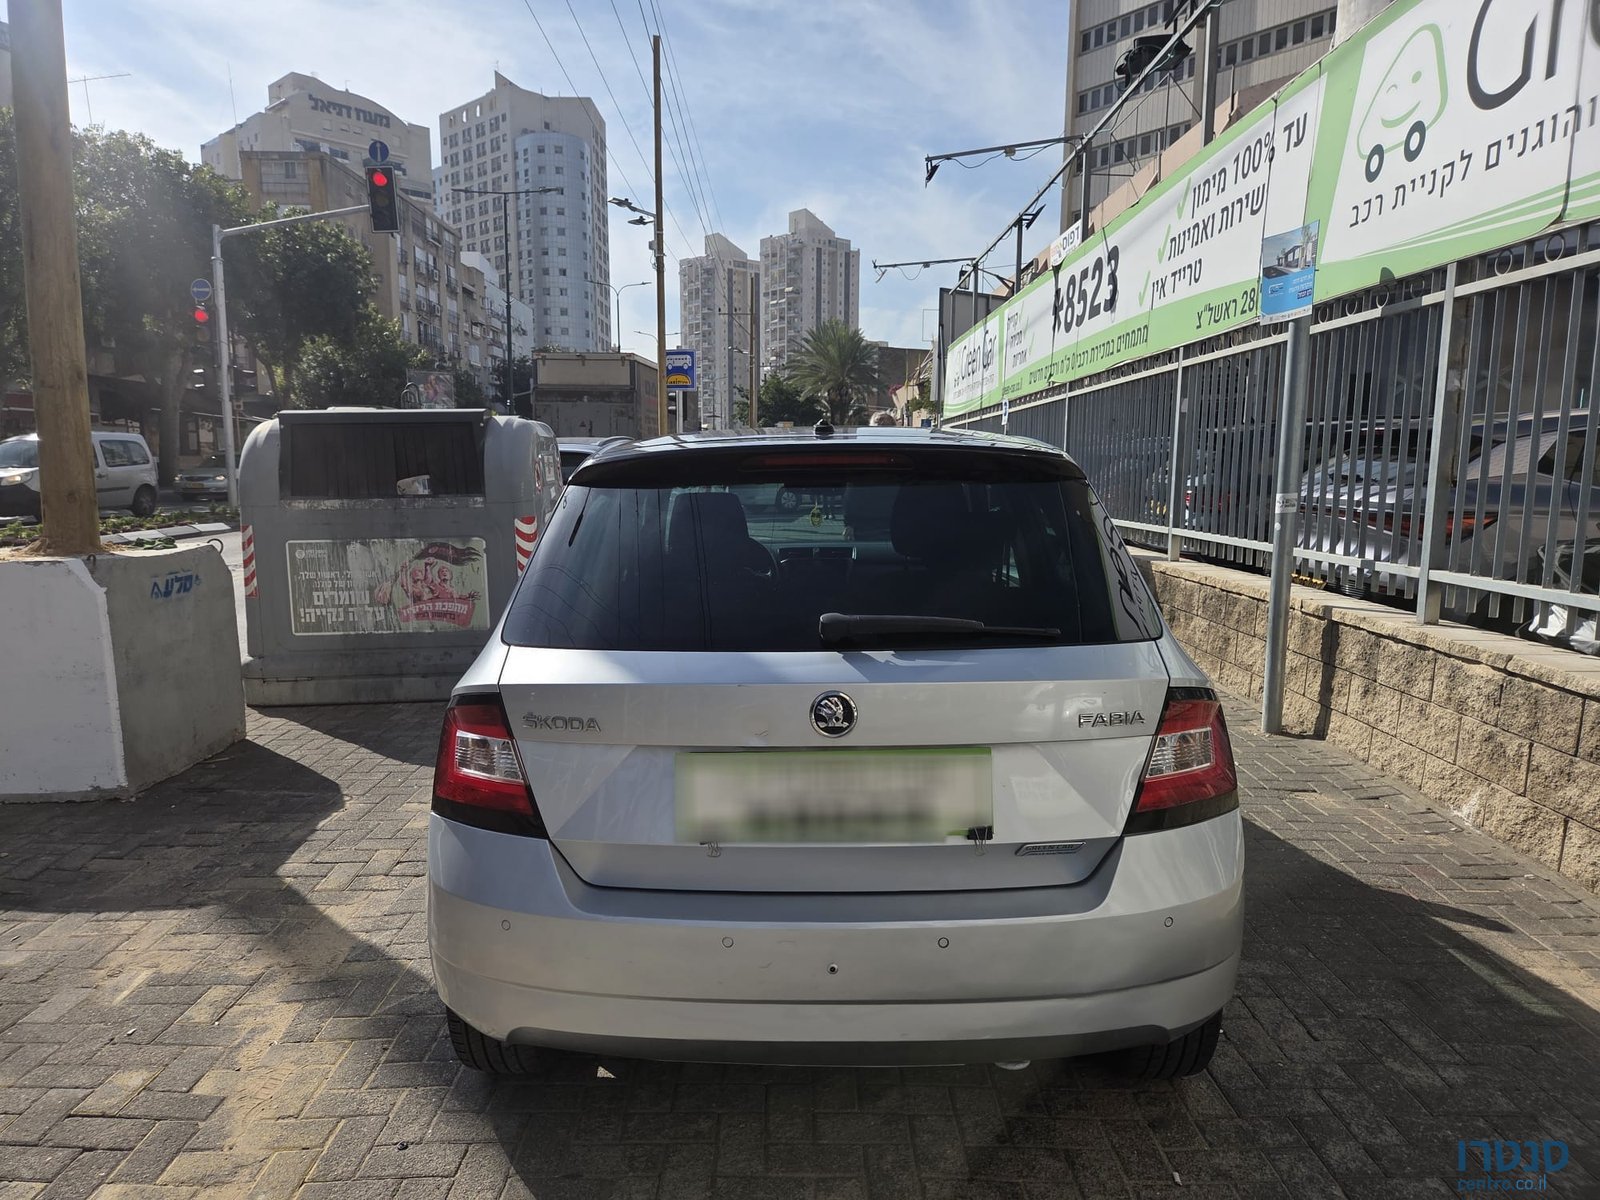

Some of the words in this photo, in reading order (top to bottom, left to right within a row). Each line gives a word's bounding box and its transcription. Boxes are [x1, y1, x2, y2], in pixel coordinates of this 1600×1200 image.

[308, 94, 353, 119] דניאל
[1283, 112, 1308, 152] עד
[1233, 131, 1275, 185] 100%
[1191, 167, 1228, 219] מימון
[1391, 149, 1473, 210] לקניית
[1218, 183, 1267, 234] שירות
[1349, 193, 1384, 228] רכב
[1062, 226, 1081, 252] דפוס
[1167, 215, 1216, 262] ואמינות
[1171, 258, 1203, 293] טרייד
[1150, 277, 1168, 311] אין
[1240, 287, 1257, 315] 28
[1089, 338, 1115, 364] במכירת
[1117, 323, 1149, 353] מתמחים
[312, 590, 370, 605] שומרים
[300, 607, 345, 624] נקייה!
[1078, 709, 1146, 729] FABIA
